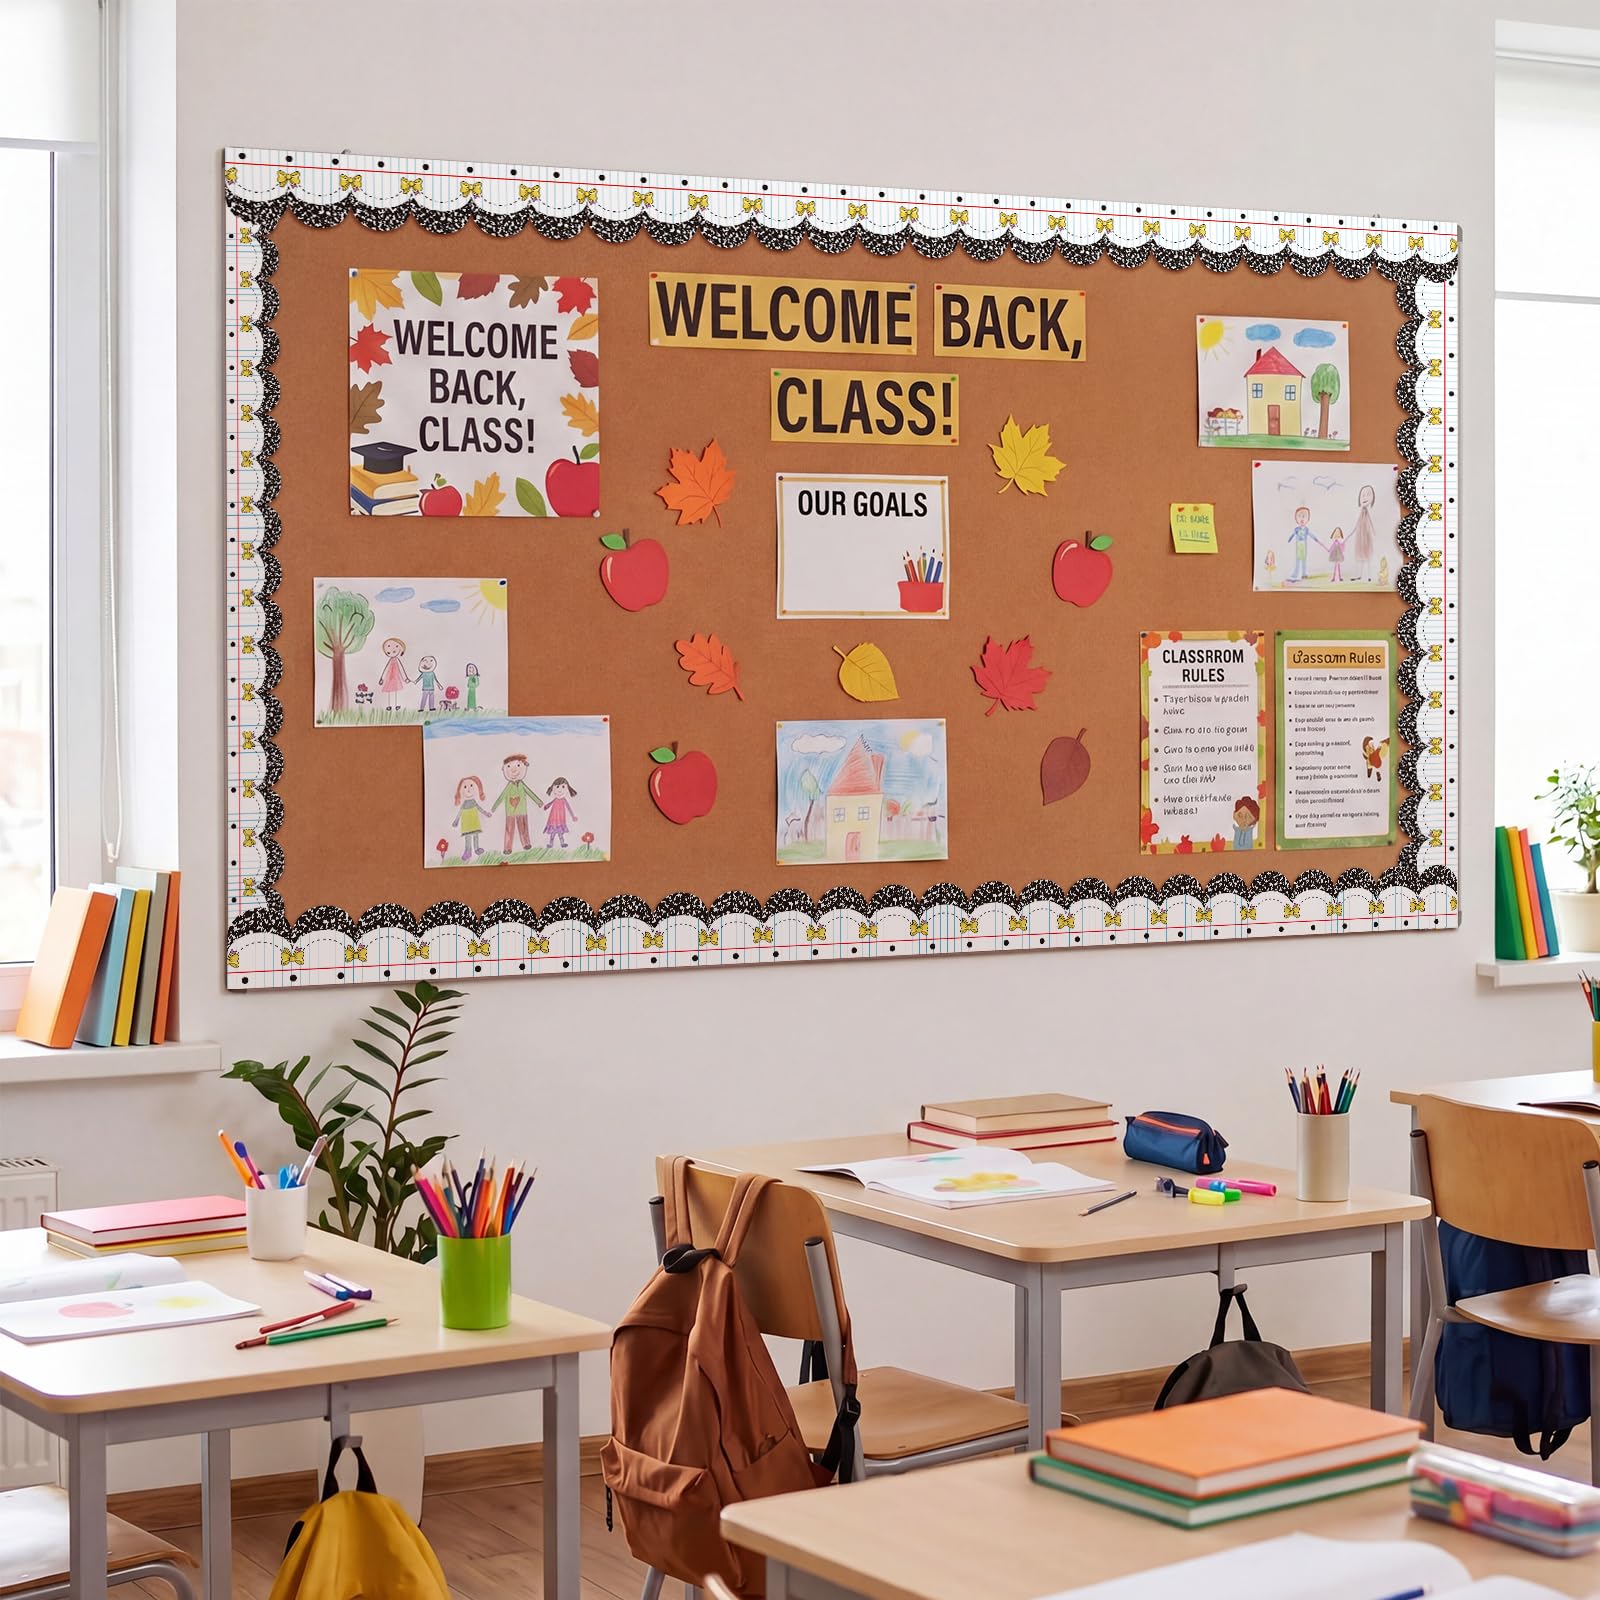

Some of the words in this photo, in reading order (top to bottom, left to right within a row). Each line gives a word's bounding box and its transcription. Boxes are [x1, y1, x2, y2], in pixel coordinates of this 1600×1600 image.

[393, 319, 558, 361] WELCOME
[655, 280, 914, 346] WELCOME
[942, 292, 1083, 361] BACK,
[429, 368, 527, 410] BACK,
[778, 376, 955, 438] CLASS!
[418, 415, 536, 455] CLASS!
[799, 489, 846, 516] OUR
[853, 491, 929, 518] GOALS
[1162, 649, 1244, 664] CLASSRROM
[1182, 668, 1225, 682] RULES
[1349, 651, 1382, 664] Rules
